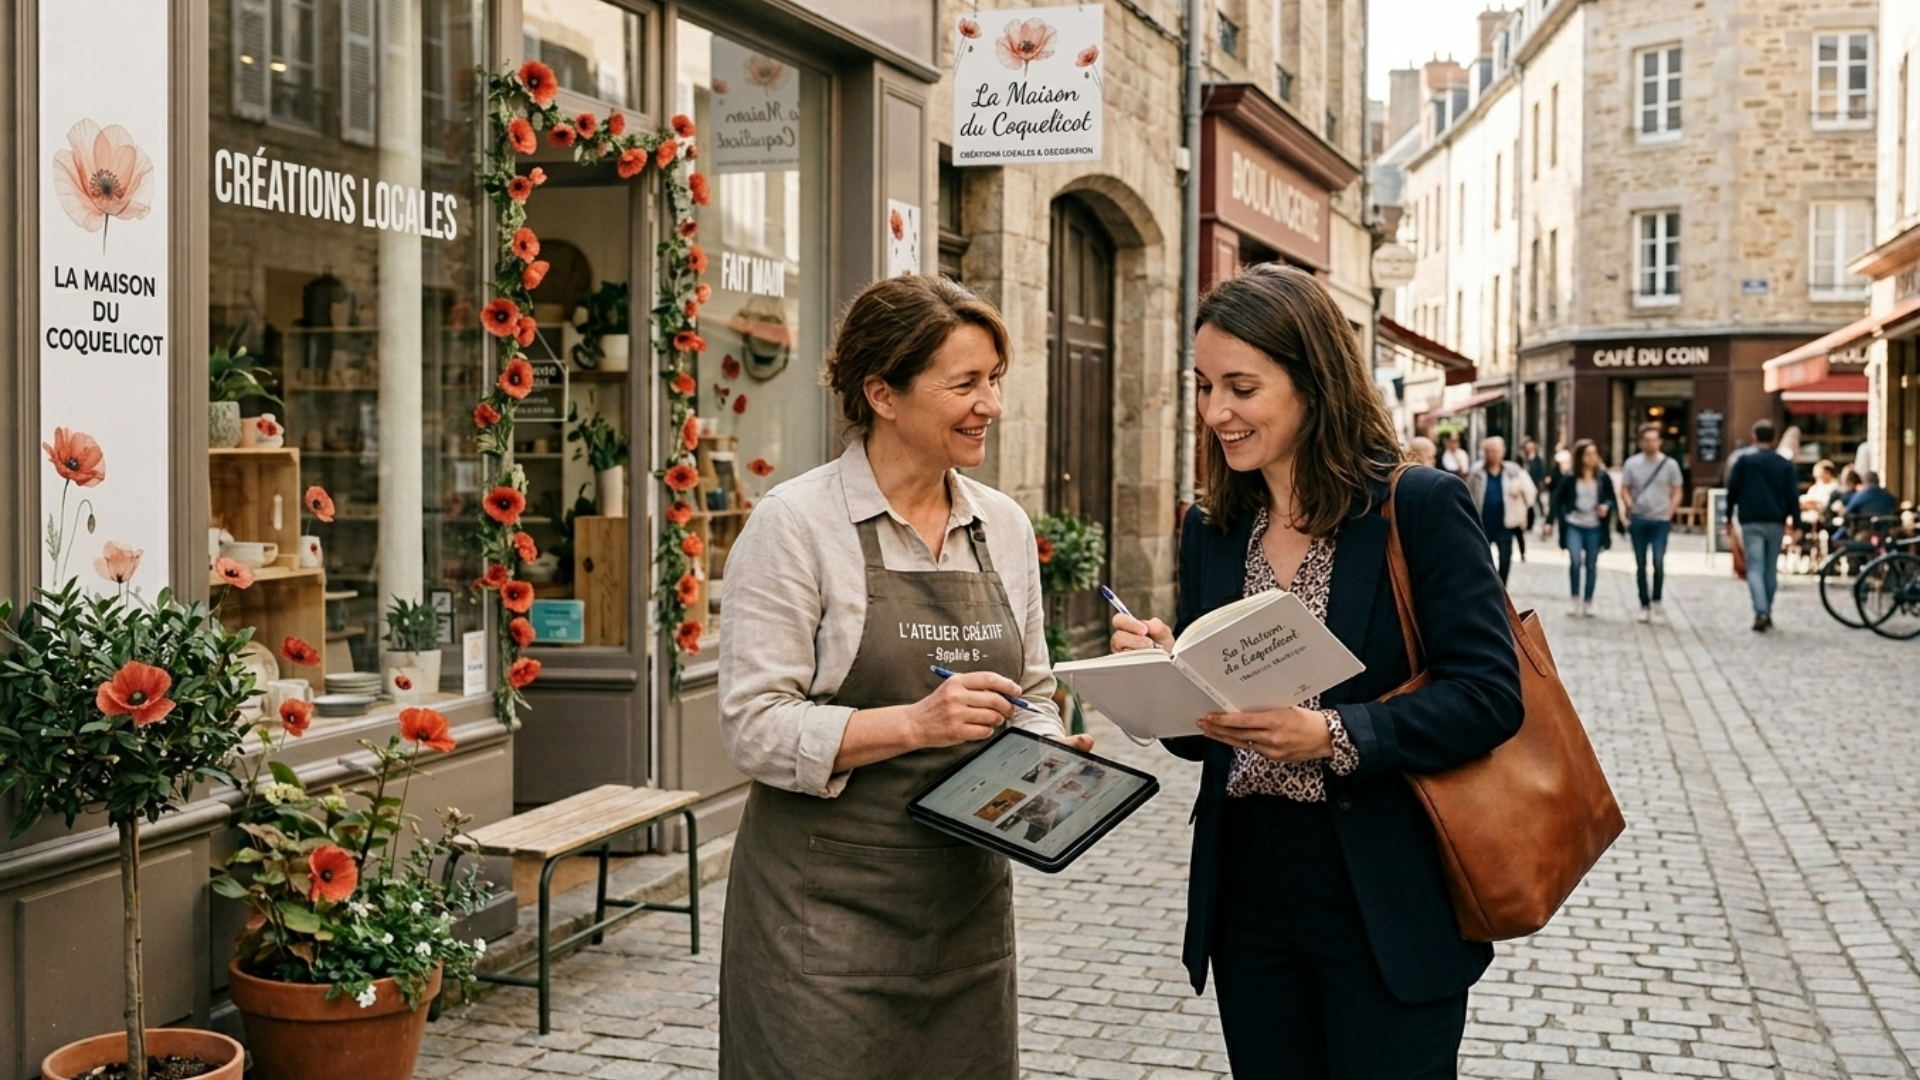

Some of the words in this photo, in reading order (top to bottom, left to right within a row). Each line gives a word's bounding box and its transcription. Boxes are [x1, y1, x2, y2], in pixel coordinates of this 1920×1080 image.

[971, 82, 1001, 108] La
[1006, 81, 1080, 106] Maison
[960, 112, 986, 136] du
[992, 108, 1092, 141] Coquelicot
[214, 146, 356, 224] CRÉATIONS
[363, 177, 458, 241] LOCALES
[54, 265, 79, 289] LA
[84, 269, 155, 297] MAISON
[721, 251, 751, 293] FAIT
[93, 300, 119, 323] DU
[46, 327, 164, 356] COQUELICOT
[1592, 346, 1636, 368] CAFÉ
[1637, 347, 1663, 366] DU
[1665, 345, 1710, 366] COIN
[899, 622, 960, 641] L'ATELIER
